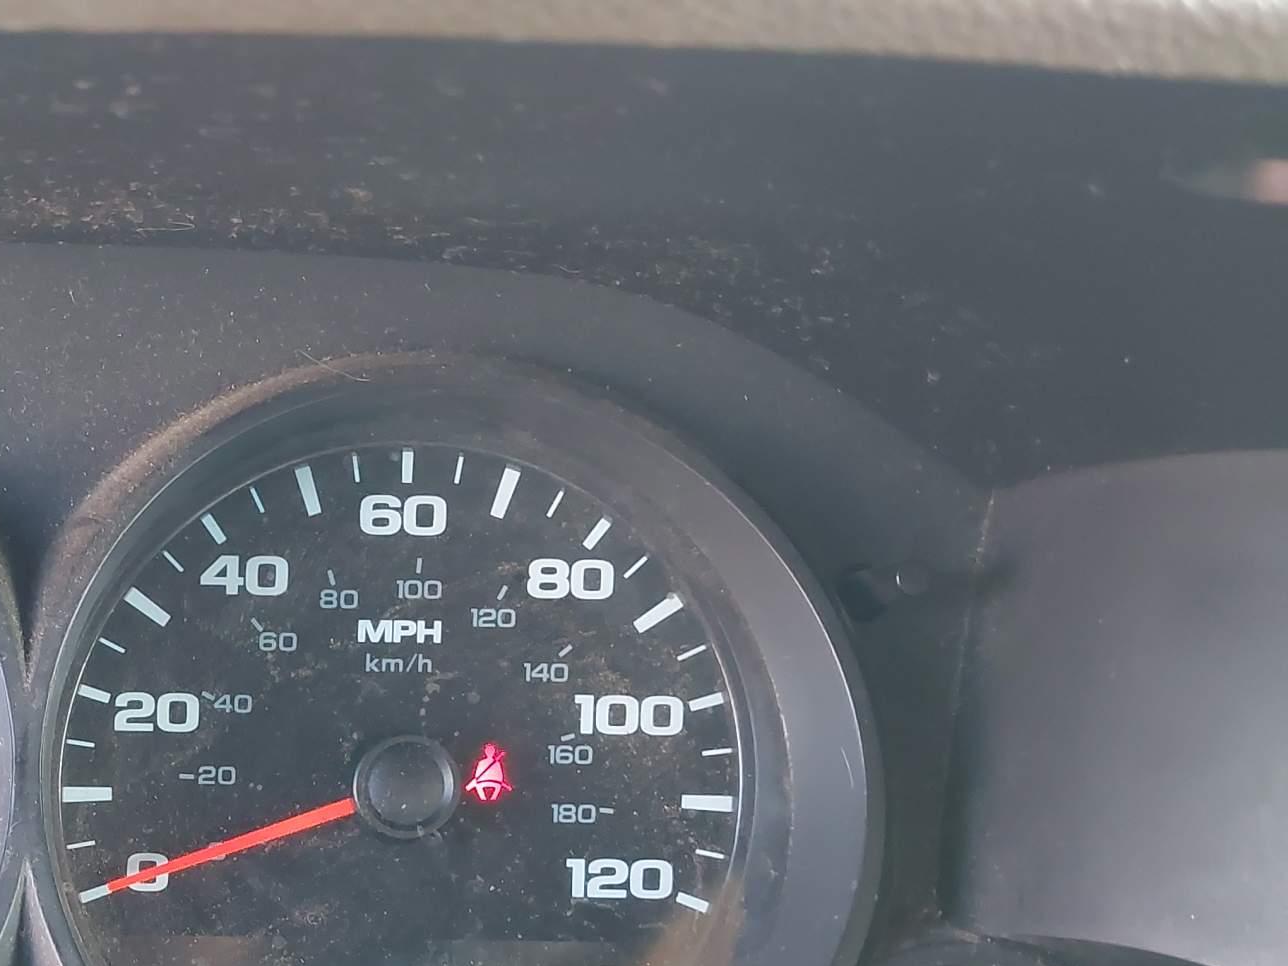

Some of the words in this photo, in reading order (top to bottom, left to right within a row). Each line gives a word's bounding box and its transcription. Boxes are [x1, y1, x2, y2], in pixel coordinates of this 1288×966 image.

[359, 494, 448, 536] 60
[199, 555, 289, 596] 40
[526, 558, 615, 600] 80
[319, 588, 360, 611] 80
[396, 579, 443, 600] 100
[470, 607, 516, 629] 120
[258, 631, 298, 653] 60
[357, 619, 443, 645] MPH
[364, 653, 433, 674] km/h
[523, 661, 570, 683] 140
[113, 691, 200, 734] 20
[213, 693, 253, 714] 40
[574, 694, 684, 736] 100
[547, 744, 594, 766] 160
[196, 766, 237, 786] 20
[550, 803, 596, 825] 180
[125, 852, 169, 893] 0
[565, 858, 674, 900] 120
